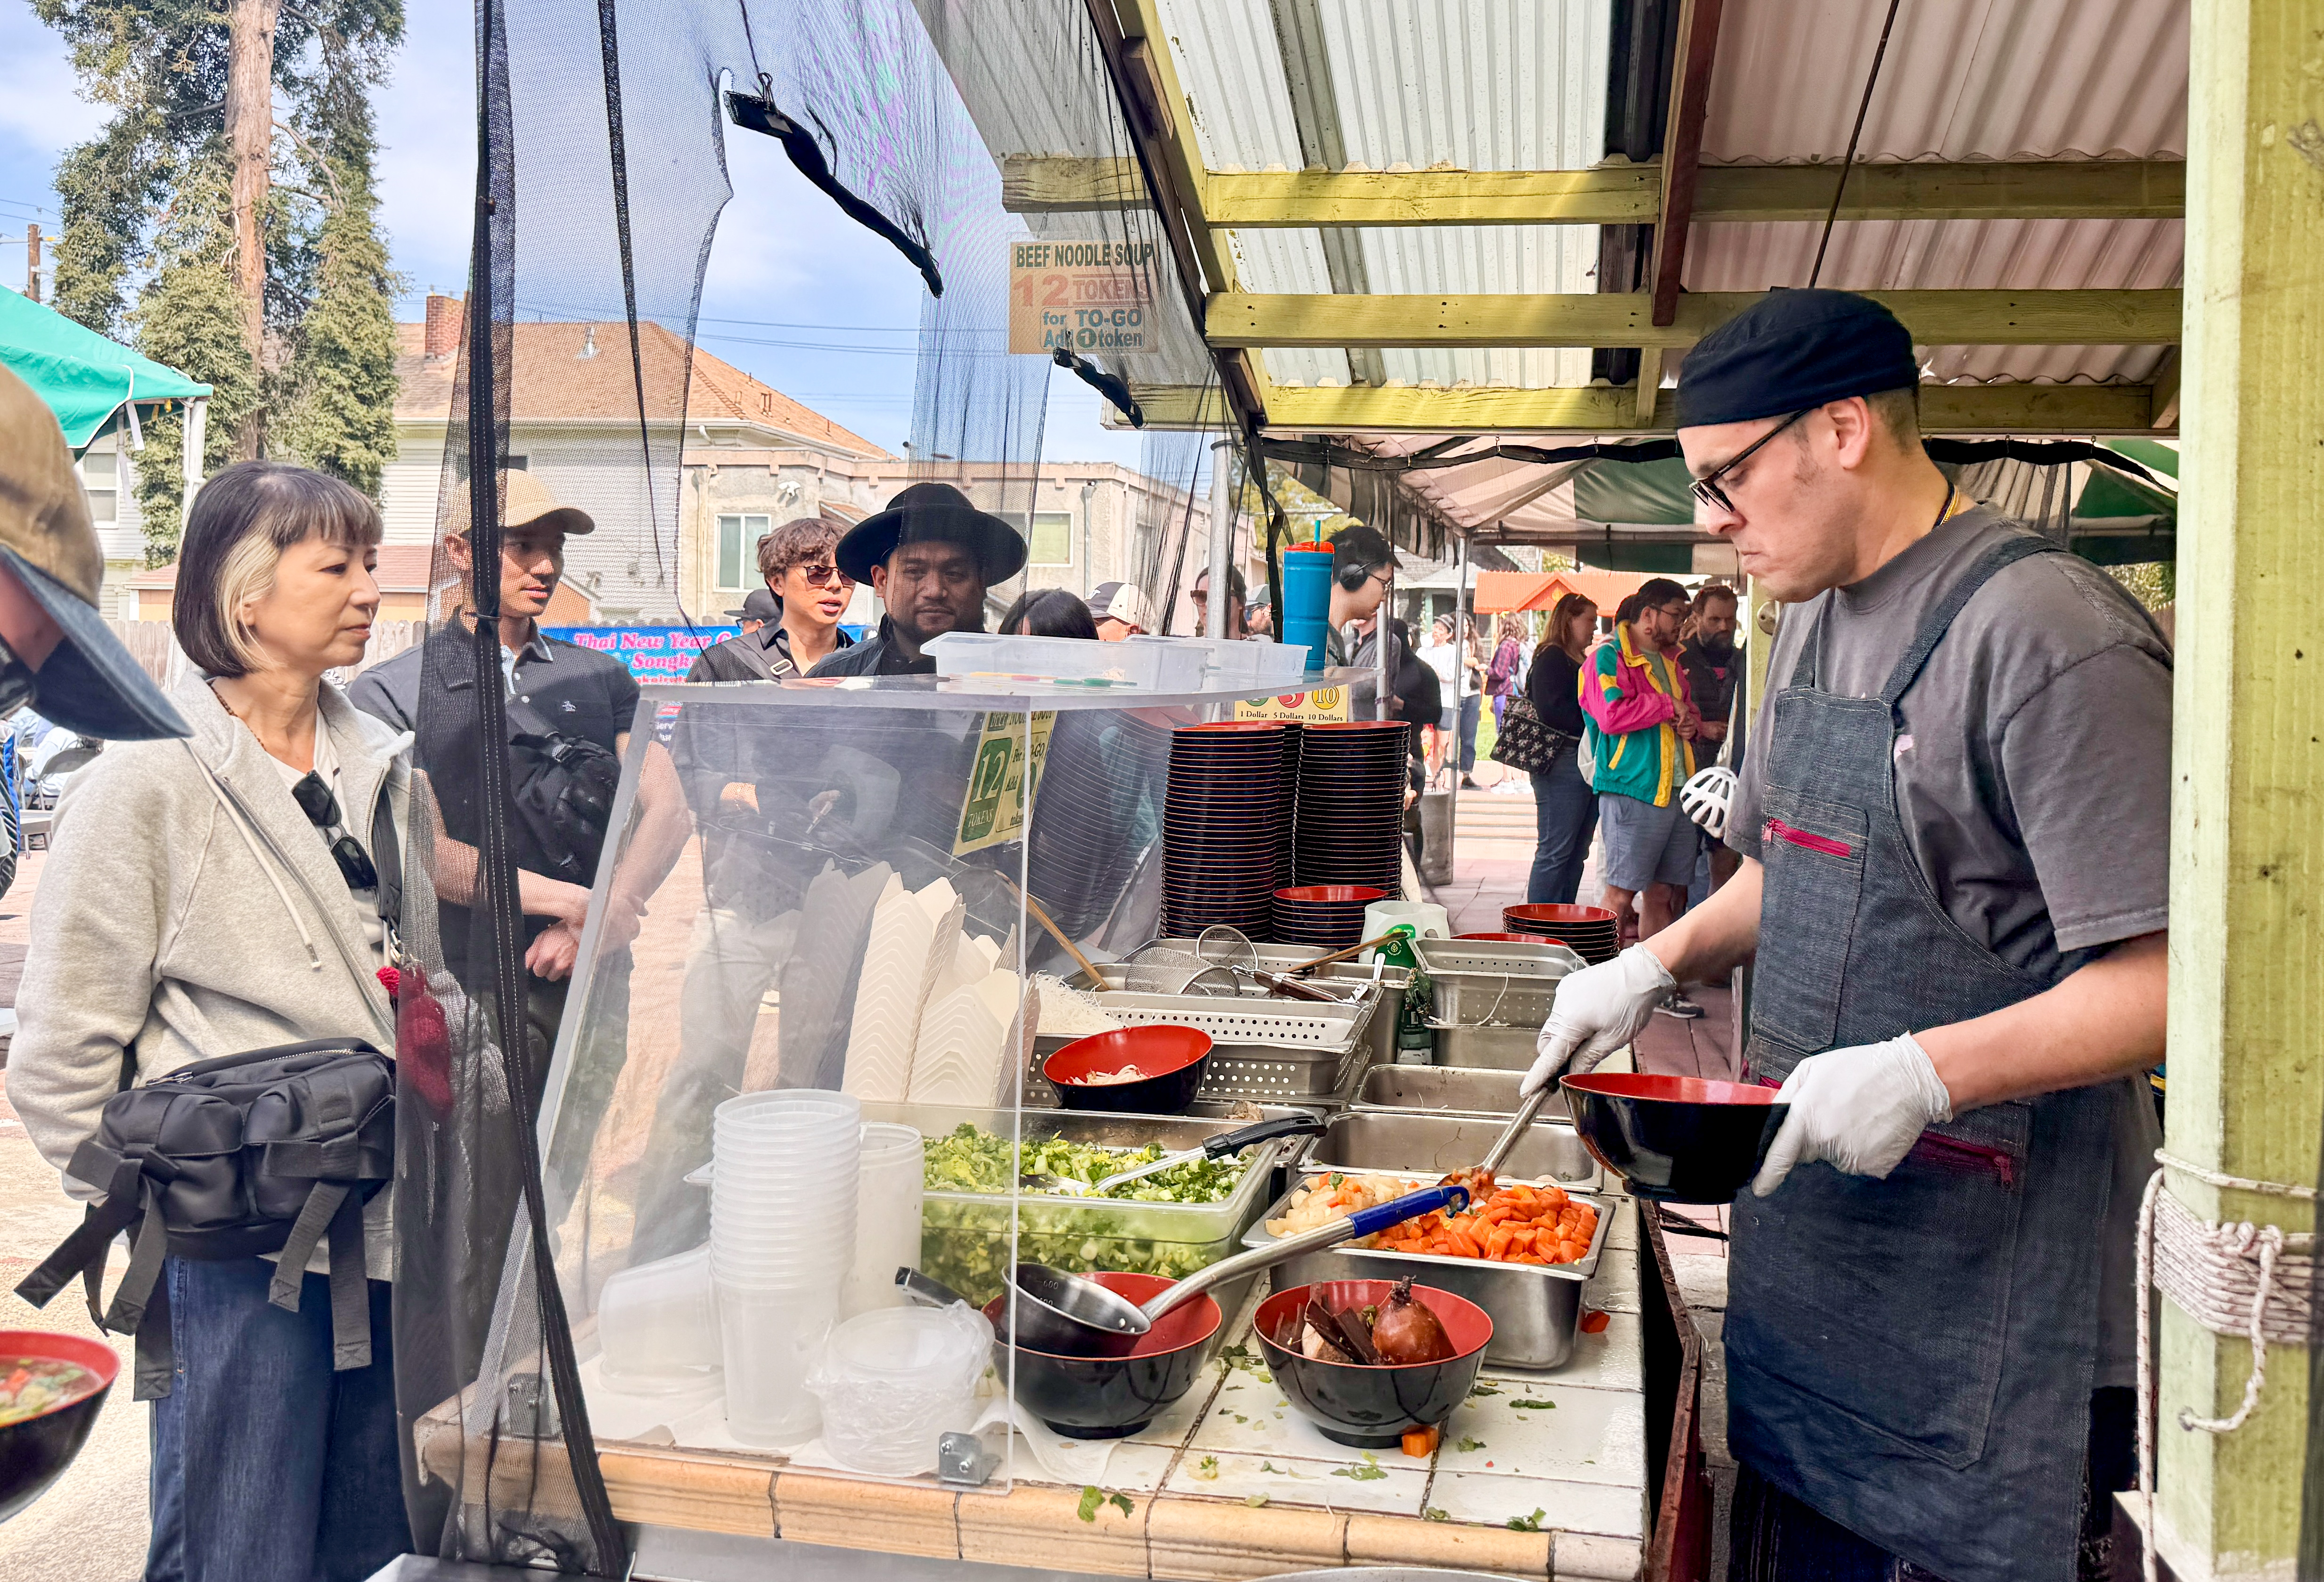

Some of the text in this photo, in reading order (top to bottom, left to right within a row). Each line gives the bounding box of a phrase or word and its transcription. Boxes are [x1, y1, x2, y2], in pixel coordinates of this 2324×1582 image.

[1016, 244, 1153, 267] BEEF NOODLE SOUP
[1014, 275, 1069, 306] 12
[1072, 280, 1150, 300] TOKENS
[1043, 309, 1142, 327] for TO-GO
[1099, 329, 1143, 347] token
[574, 633, 616, 650] Thai
[621, 633, 664, 649] New
[670, 632, 712, 649] Year
[1316, 686, 1336, 703] 10
[1013, 748, 1022, 763] For
[973, 750, 1005, 802] 12
[968, 808, 994, 828] TOKENS
[1044, 1280, 1058, 1289] 600
